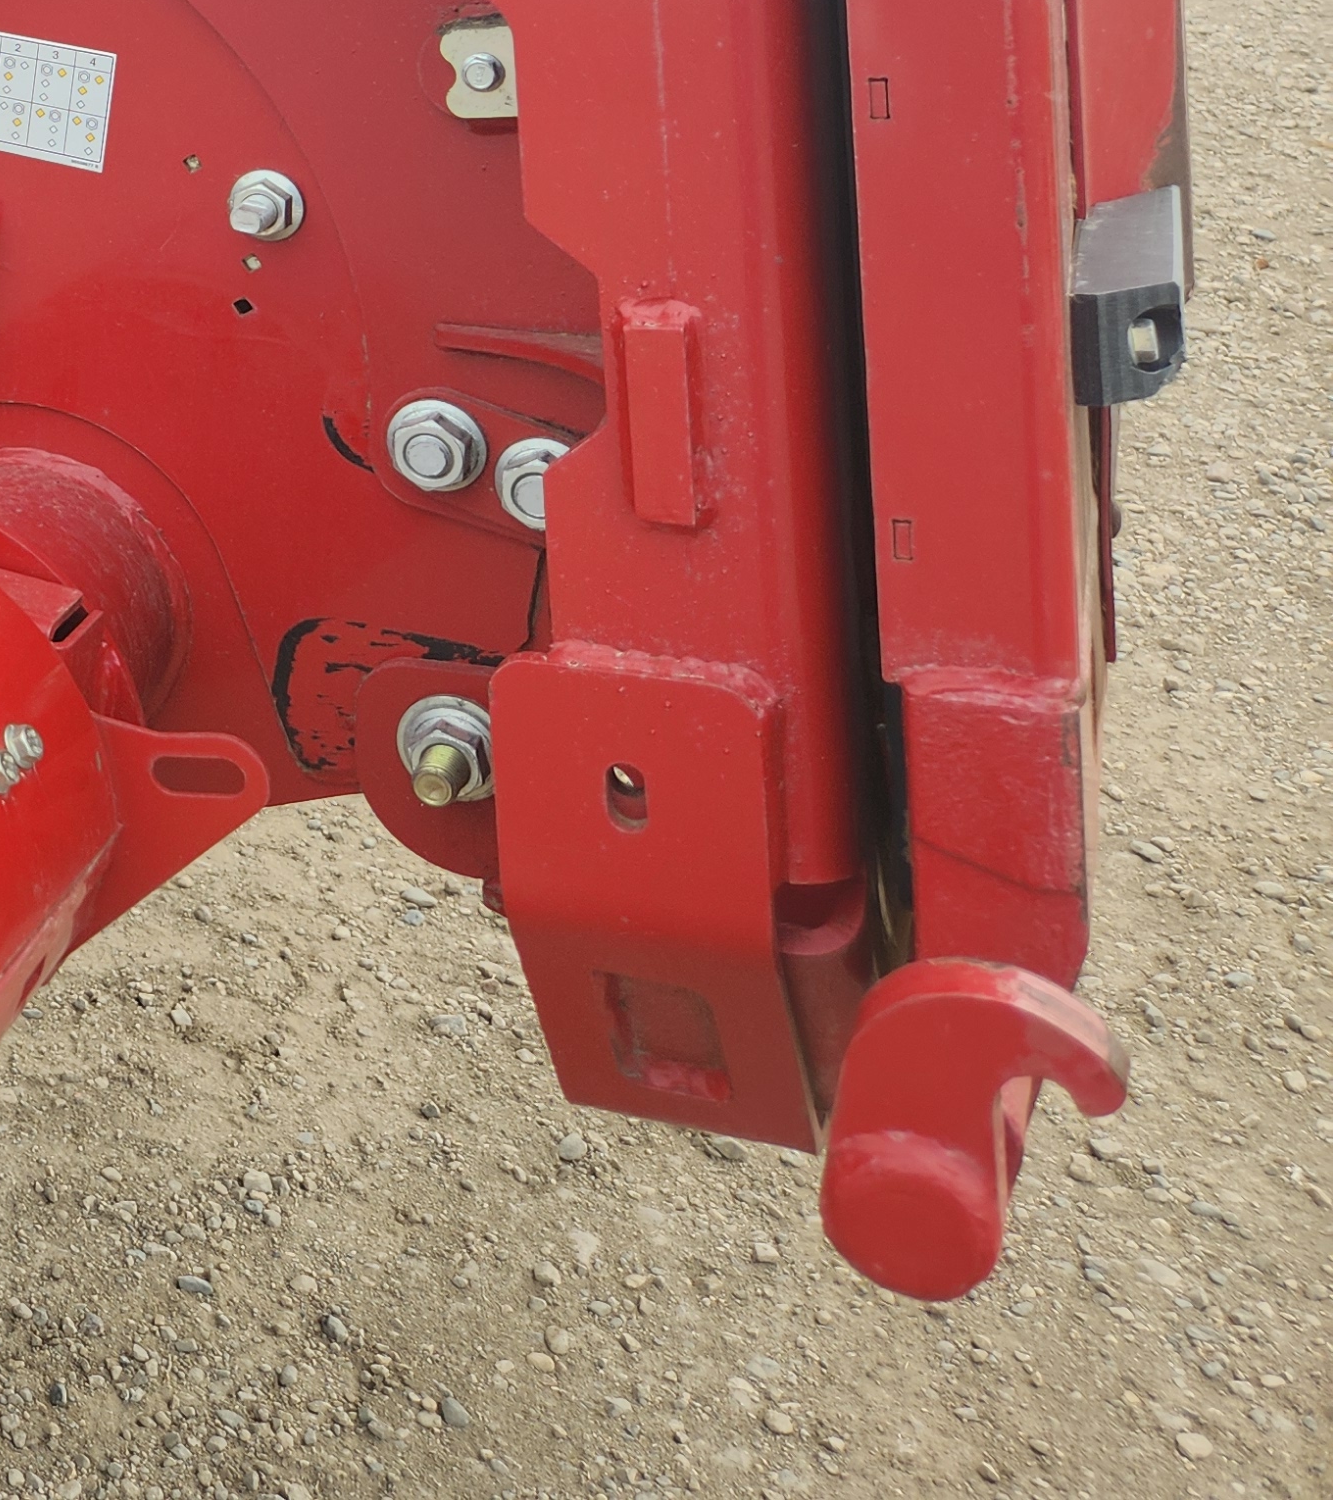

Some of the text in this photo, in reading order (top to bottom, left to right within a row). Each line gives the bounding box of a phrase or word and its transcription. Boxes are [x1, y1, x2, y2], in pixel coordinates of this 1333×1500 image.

[15, 43, 21, 52] 2
[53, 51, 60, 60] 3
[90, 57, 96, 66] 4
